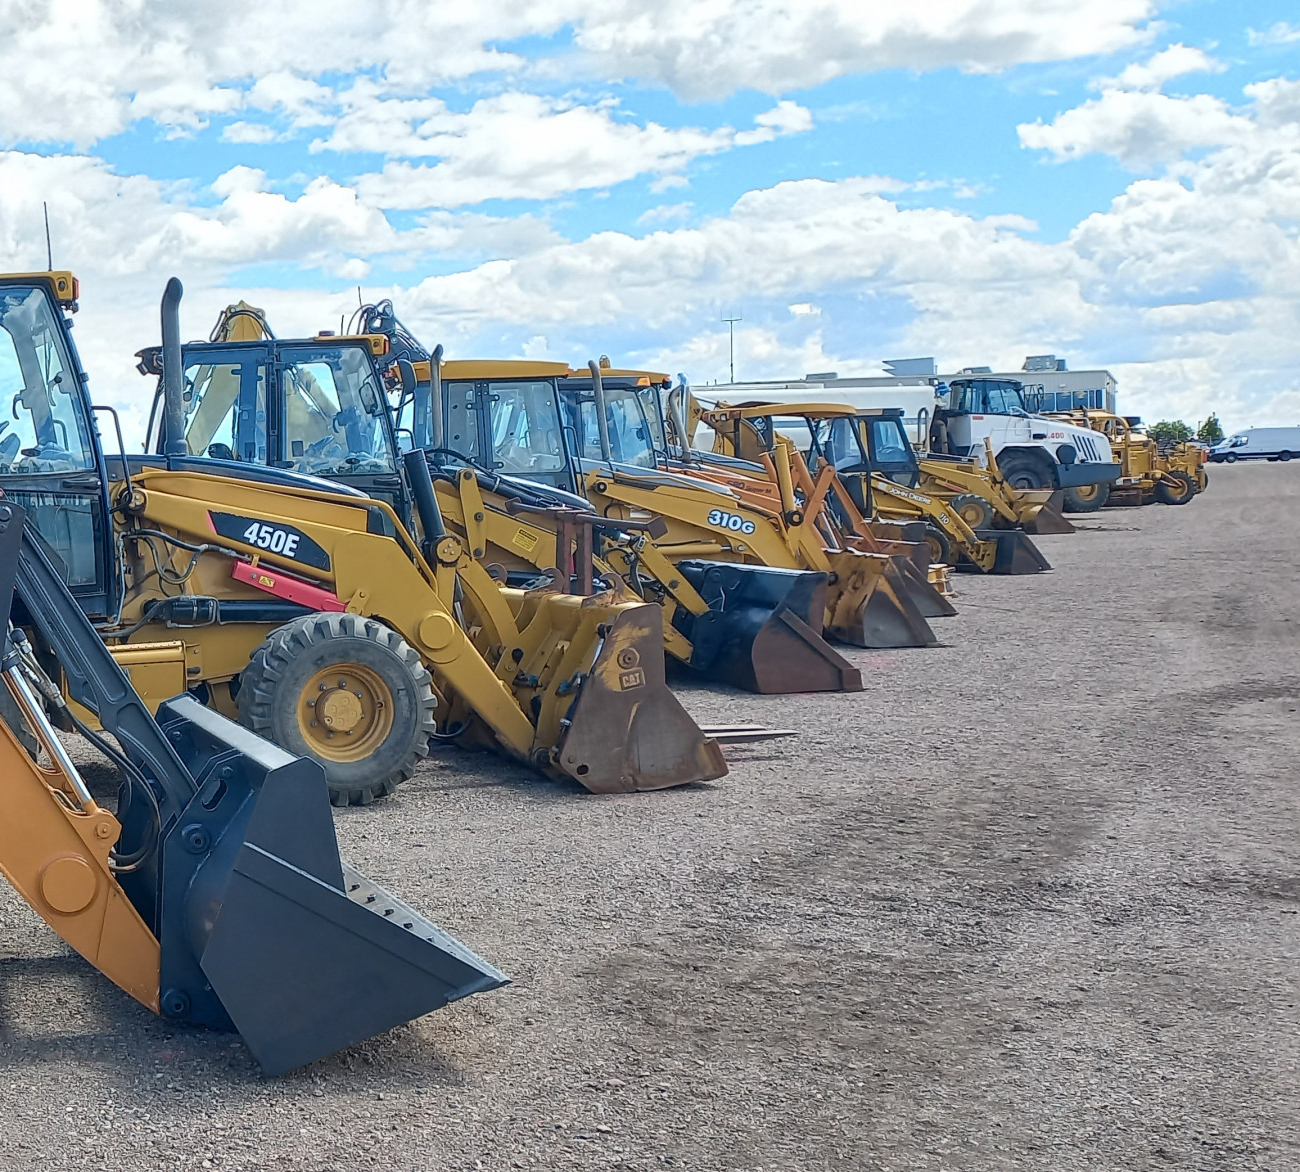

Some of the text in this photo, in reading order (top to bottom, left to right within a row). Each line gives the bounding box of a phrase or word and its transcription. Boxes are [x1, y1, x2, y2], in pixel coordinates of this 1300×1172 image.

[707, 509, 756, 535] 310G
[243, 522, 301, 558] 450E
[622, 672, 640, 688] CAT
